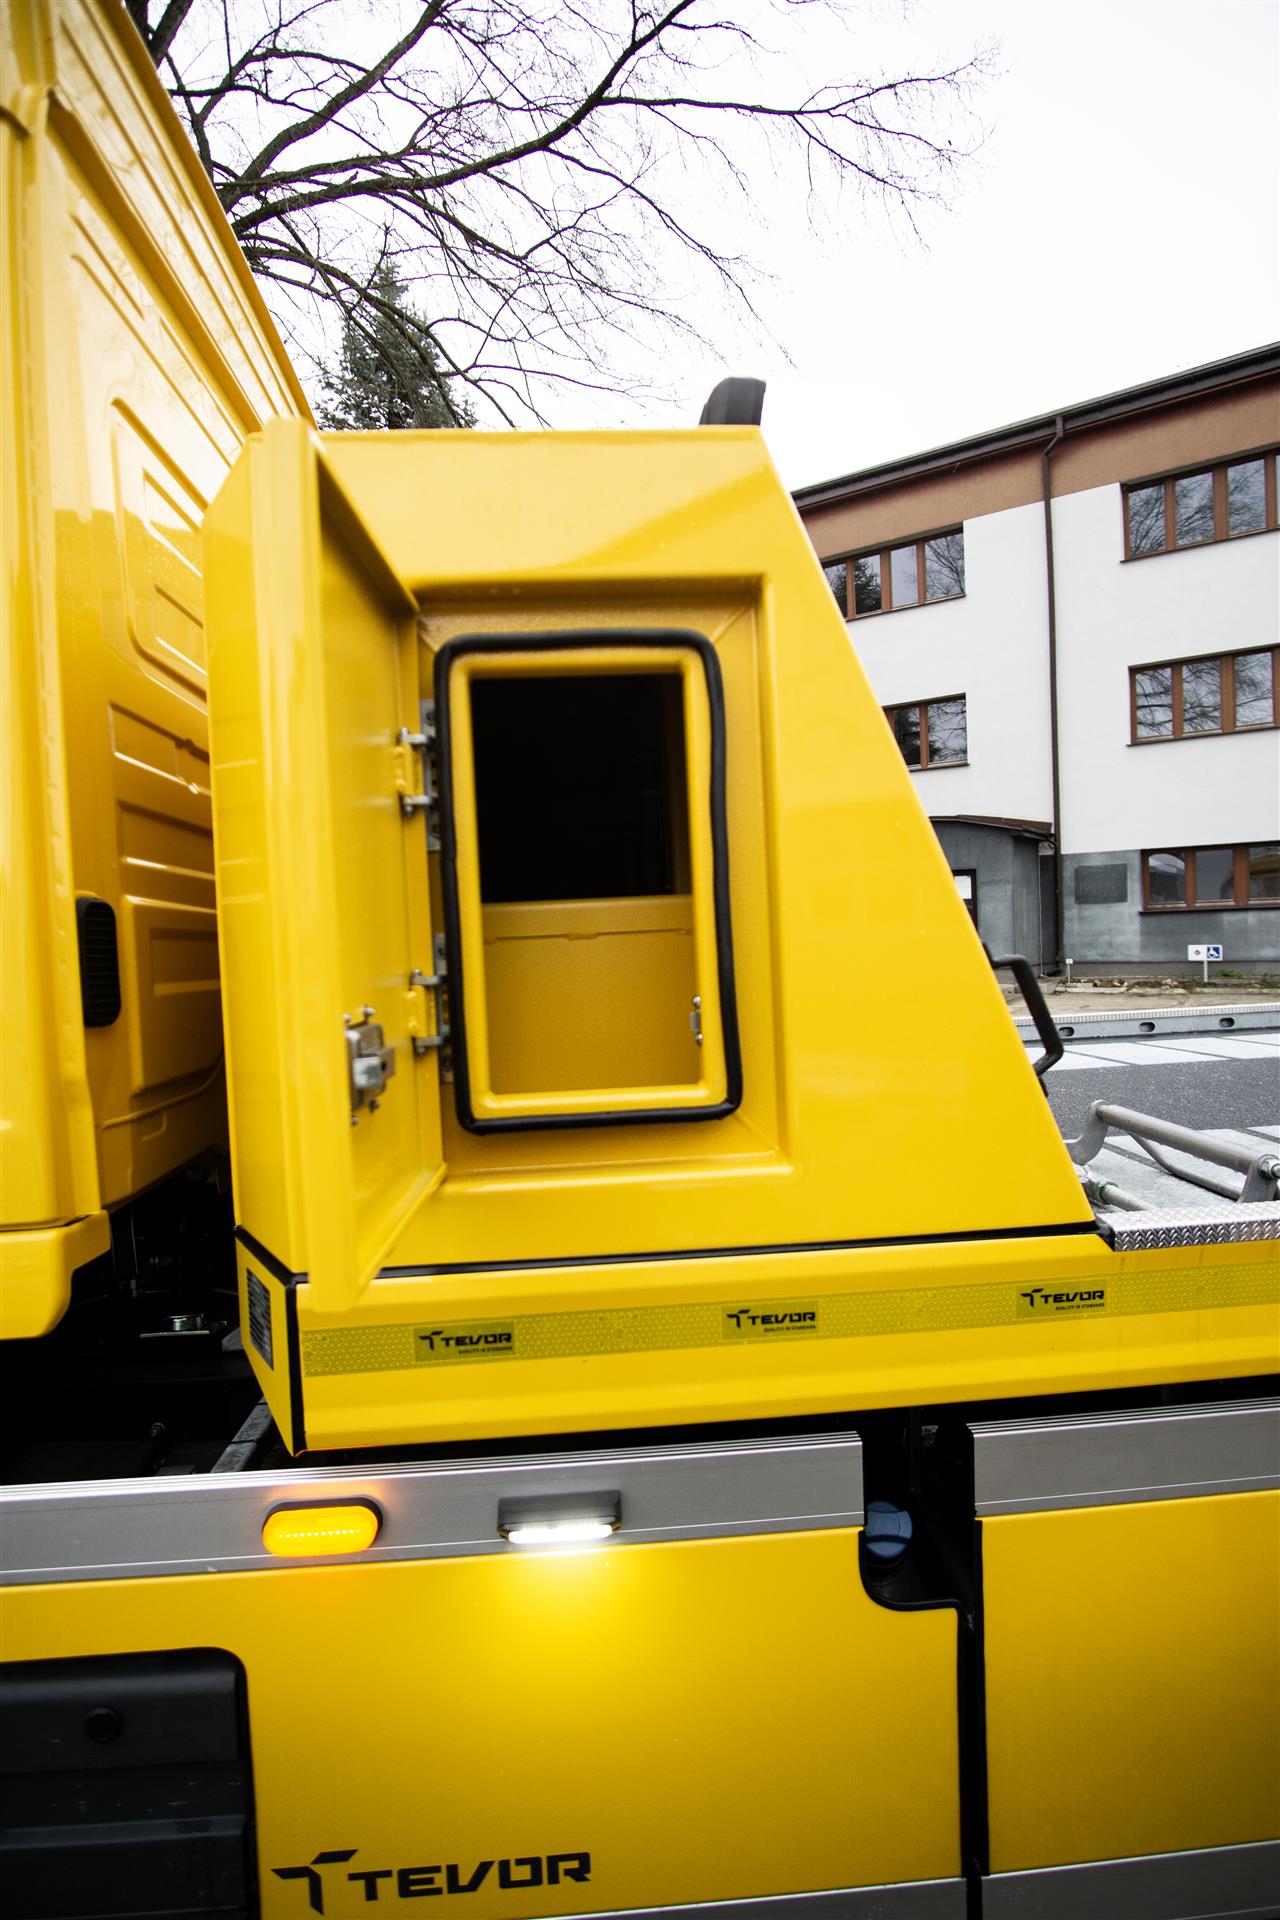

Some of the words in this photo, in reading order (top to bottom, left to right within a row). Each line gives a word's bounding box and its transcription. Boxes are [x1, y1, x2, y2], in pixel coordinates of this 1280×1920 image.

[1040, 1289, 1104, 1305] TEVOR
[747, 1311, 816, 1326] TEVOR
[440, 1332, 512, 1348] TEVOR
[347, 1851, 592, 1902] TEVOR
